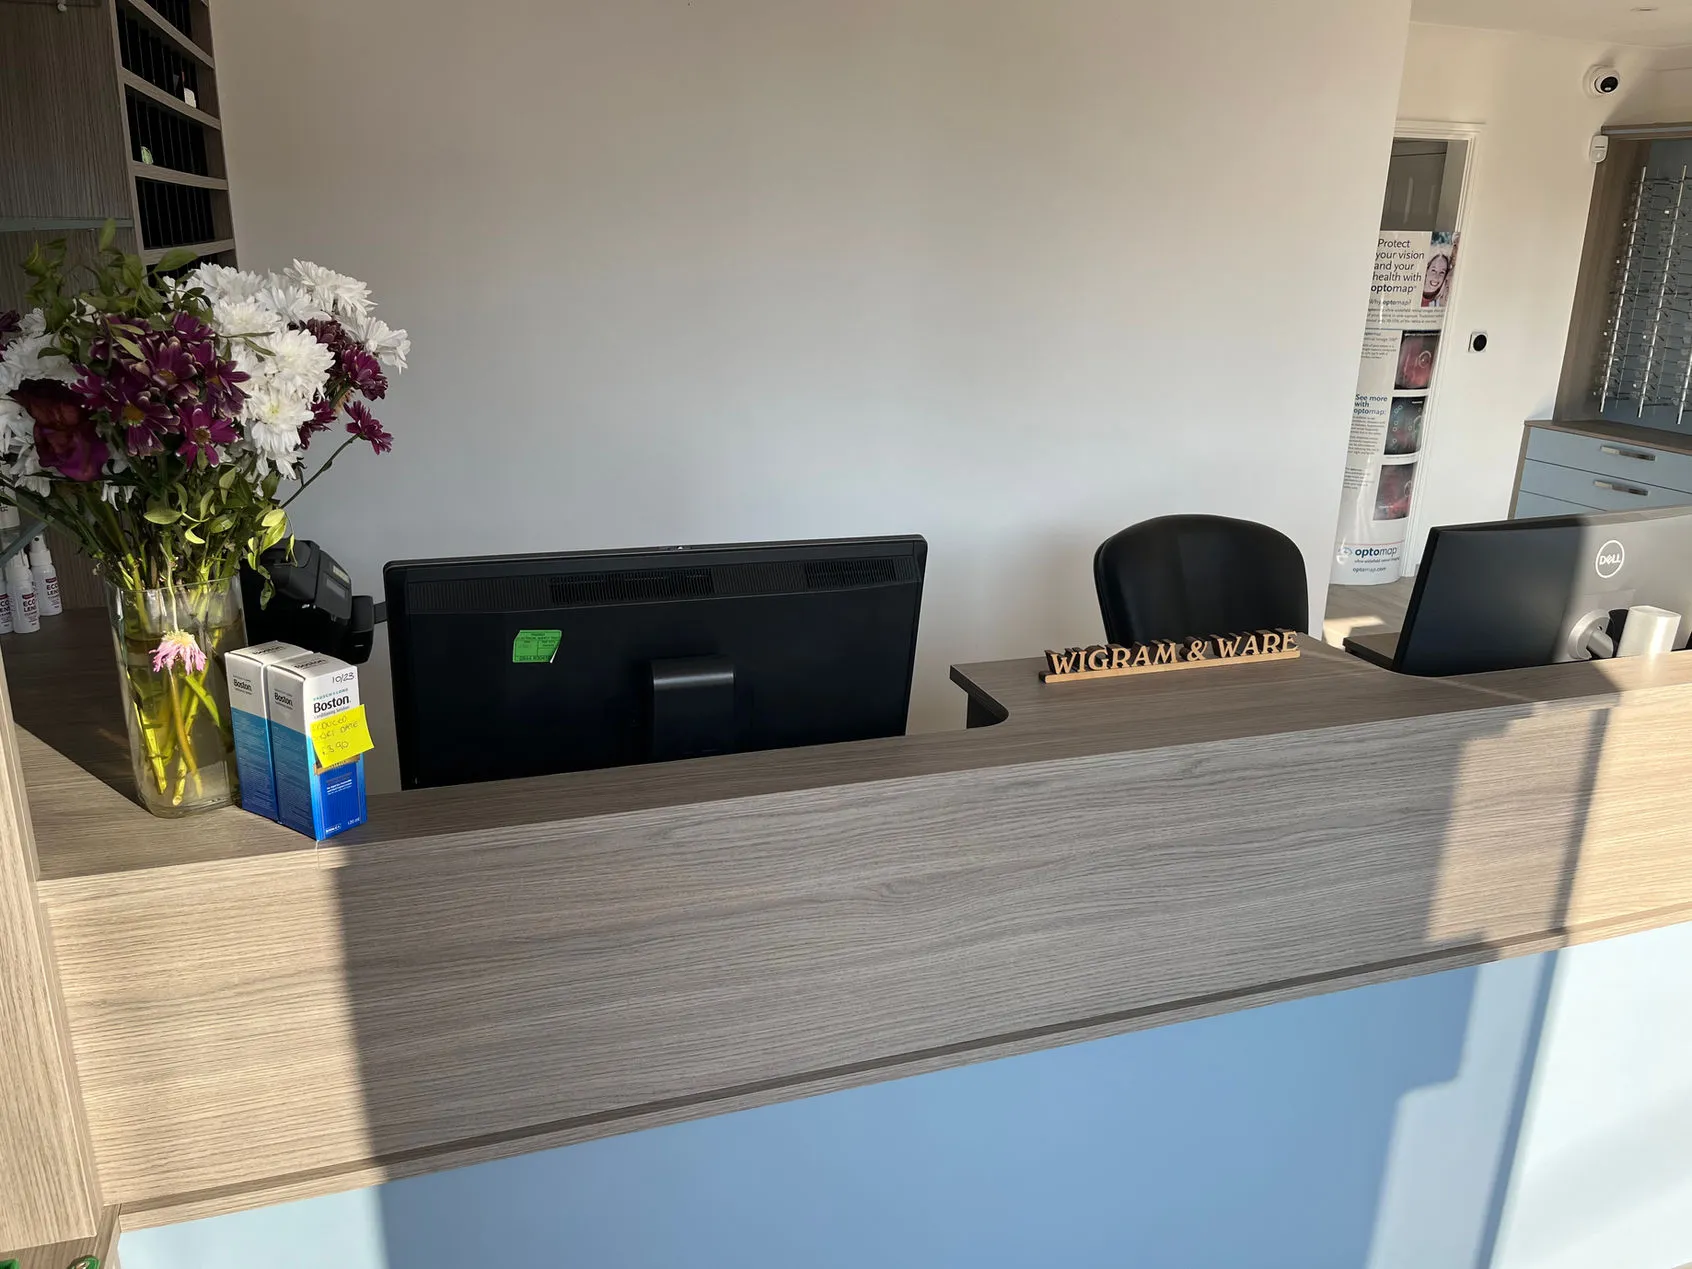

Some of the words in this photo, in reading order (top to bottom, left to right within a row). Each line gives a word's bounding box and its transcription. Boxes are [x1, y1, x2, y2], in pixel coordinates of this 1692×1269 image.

[1377, 238, 1411, 249] Protect
[1375, 251, 1396, 261] your
[1399, 251, 1425, 260] vision
[1373, 261, 1392, 271] and
[1394, 263, 1415, 273] your
[1372, 271, 1401, 281] health
[1403, 272, 1422, 282] with
[1370, 284, 1415, 295] optomap
[1354, 547, 1398, 558] optomap
[1598, 553, 1622, 566] DELL
[0, 599, 10, 607] CO
[1047, 641, 1179, 675] WIGRAM
[1186, 638, 1208, 662] &
[1216, 630, 1300, 658] WARE
[331, 672, 355, 684] 10/23
[233, 678, 253, 692] Boston
[274, 692, 294, 707] Boston
[313, 695, 350, 714] Boston
